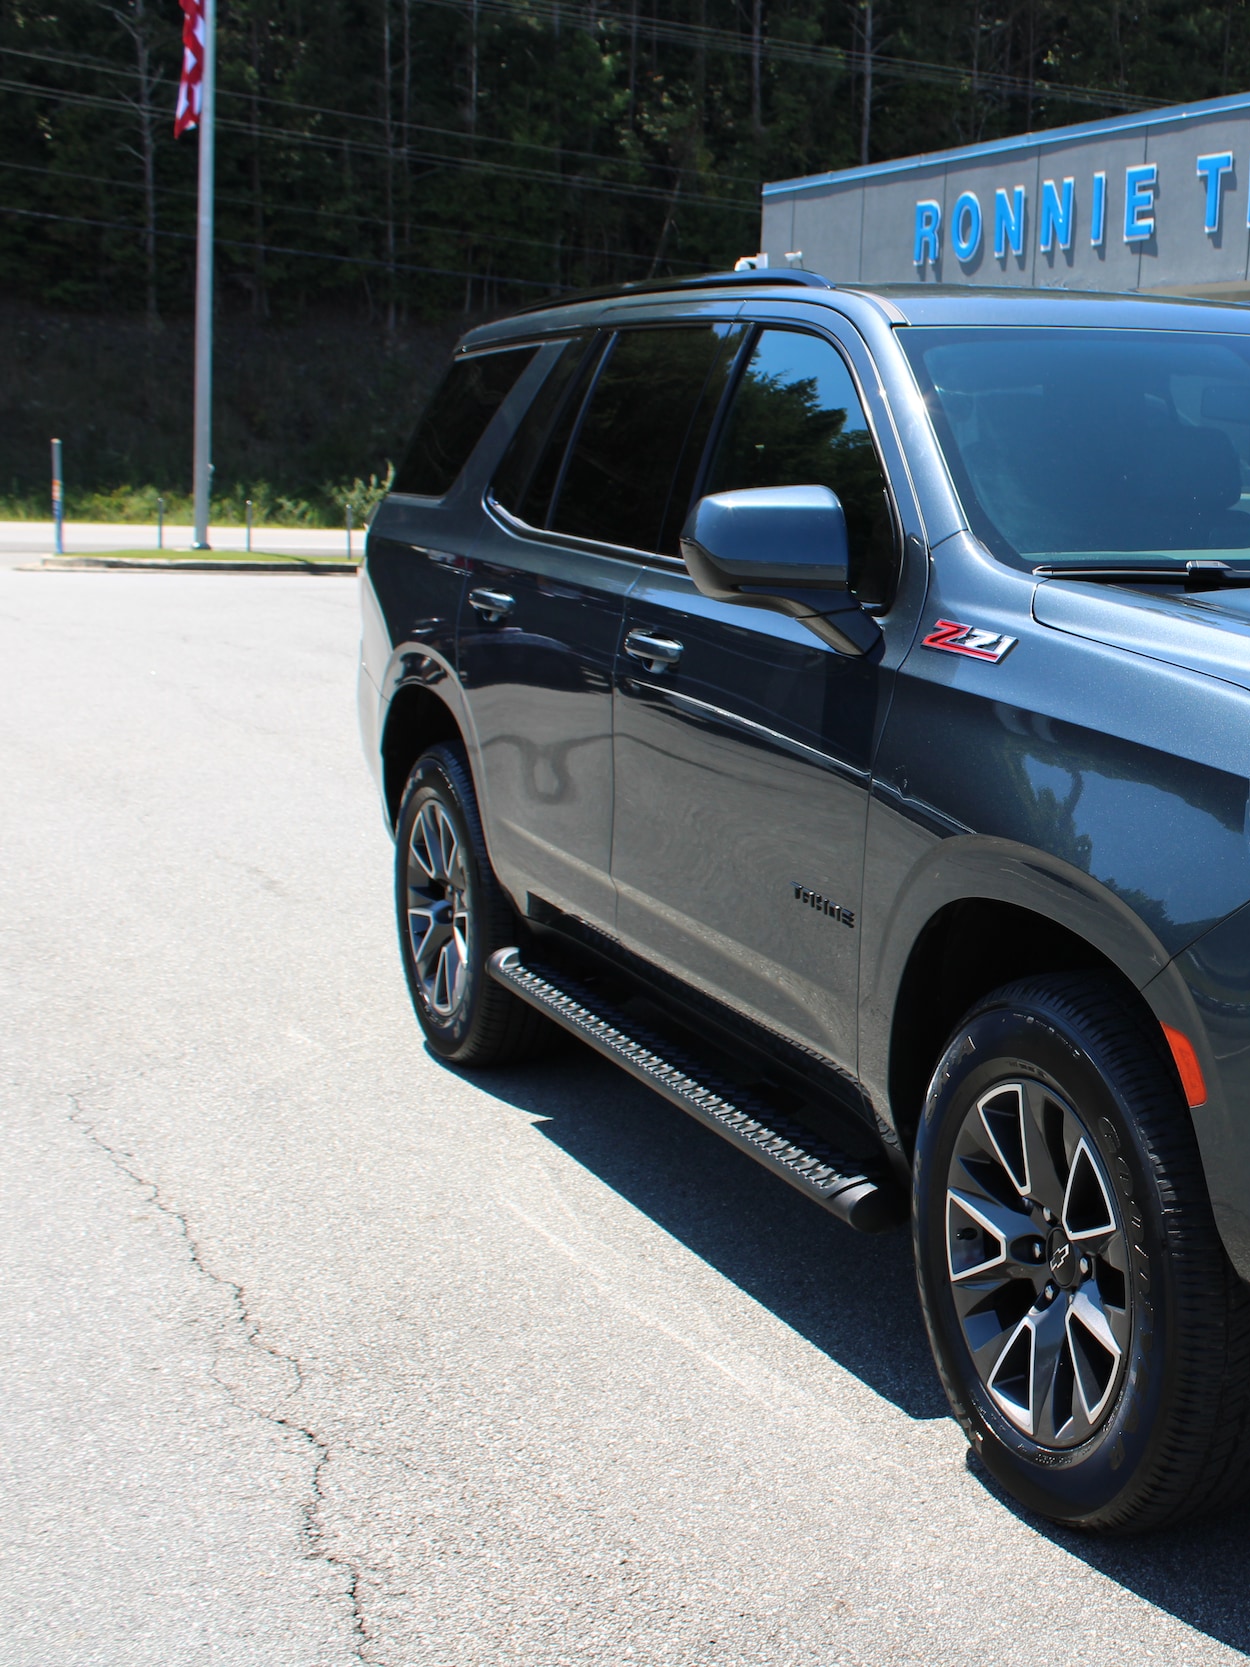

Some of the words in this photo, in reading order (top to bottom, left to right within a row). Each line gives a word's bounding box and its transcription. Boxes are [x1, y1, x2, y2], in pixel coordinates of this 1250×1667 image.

[912, 163, 1158, 267] RONNIE
[921, 618, 1018, 663] Z71
[789, 880, 855, 929] TAHOE
